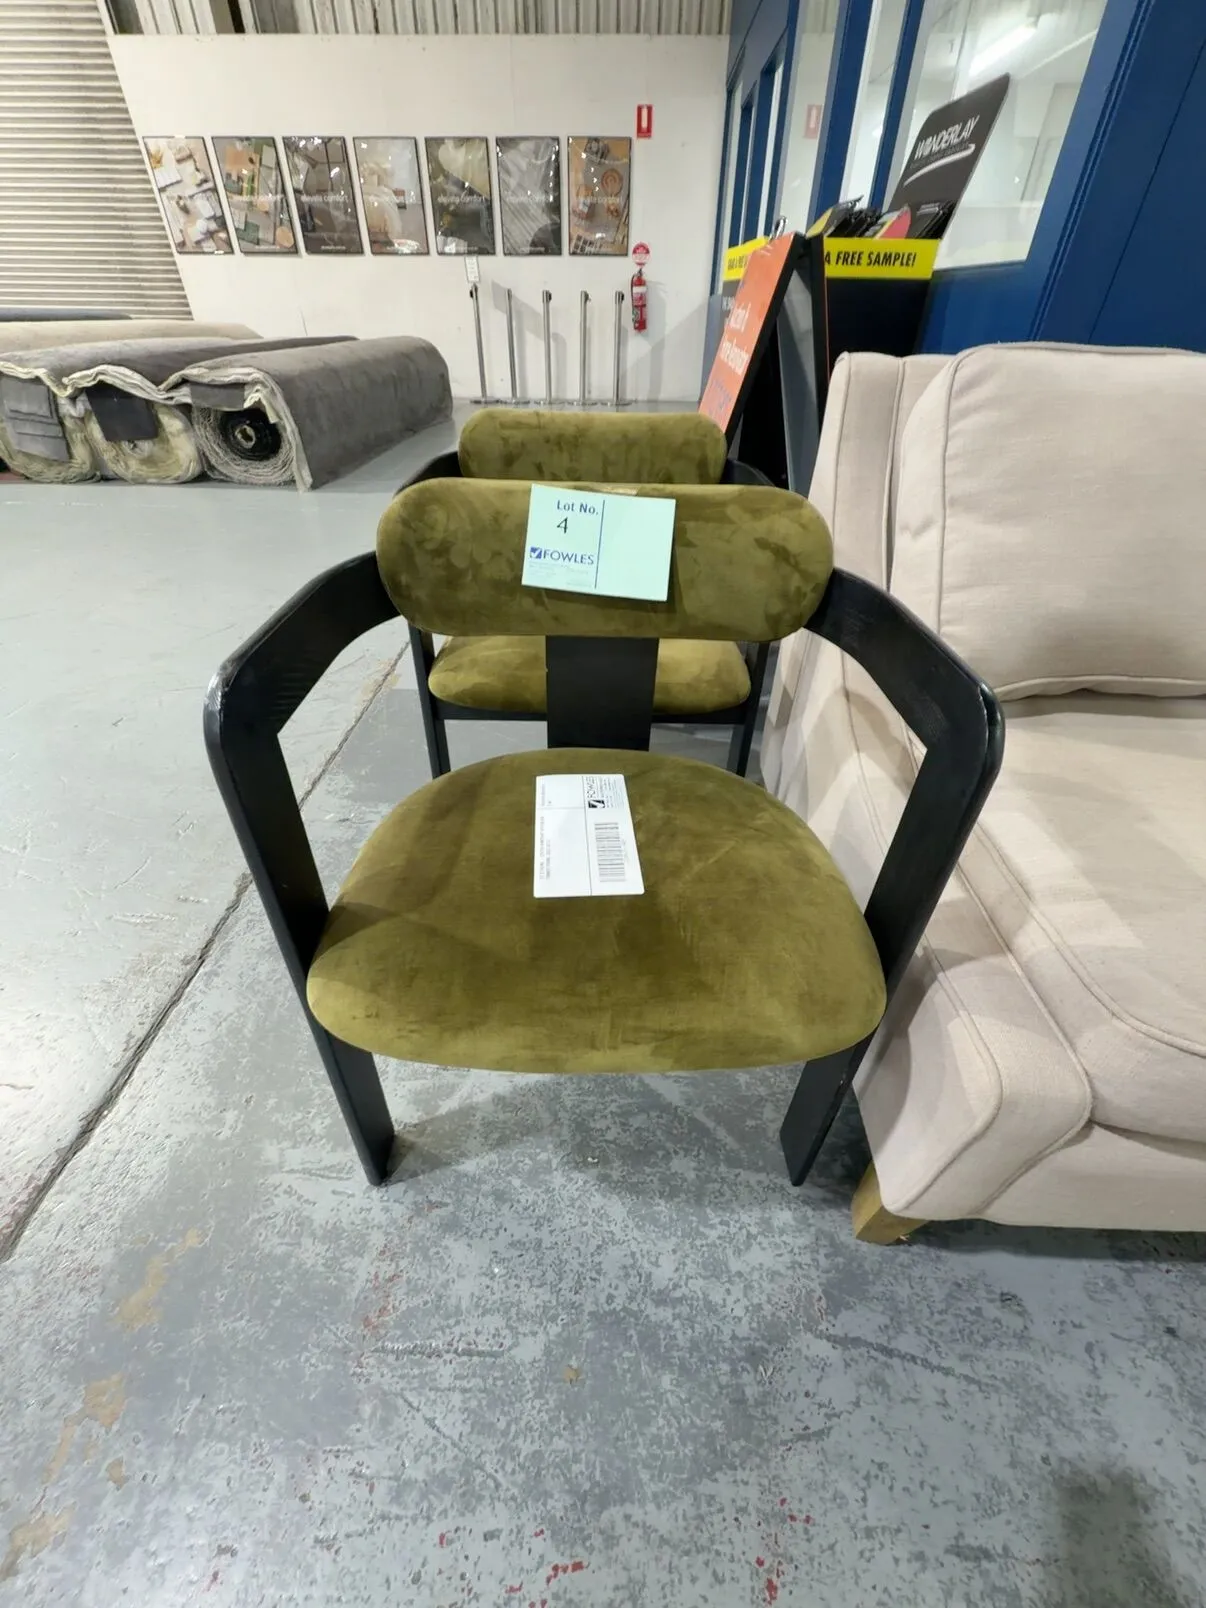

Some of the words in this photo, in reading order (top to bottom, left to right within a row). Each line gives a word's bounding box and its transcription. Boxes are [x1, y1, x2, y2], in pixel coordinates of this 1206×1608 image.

[824, 251, 831, 265] A
[835, 251, 864, 266] FREE
[867, 251, 917, 267] SAMPLE!
[556, 499, 575, 512] Lot
[579, 502, 599, 515] No.
[556, 516, 569, 534] 4
[543, 549, 595, 565] FOWLES
